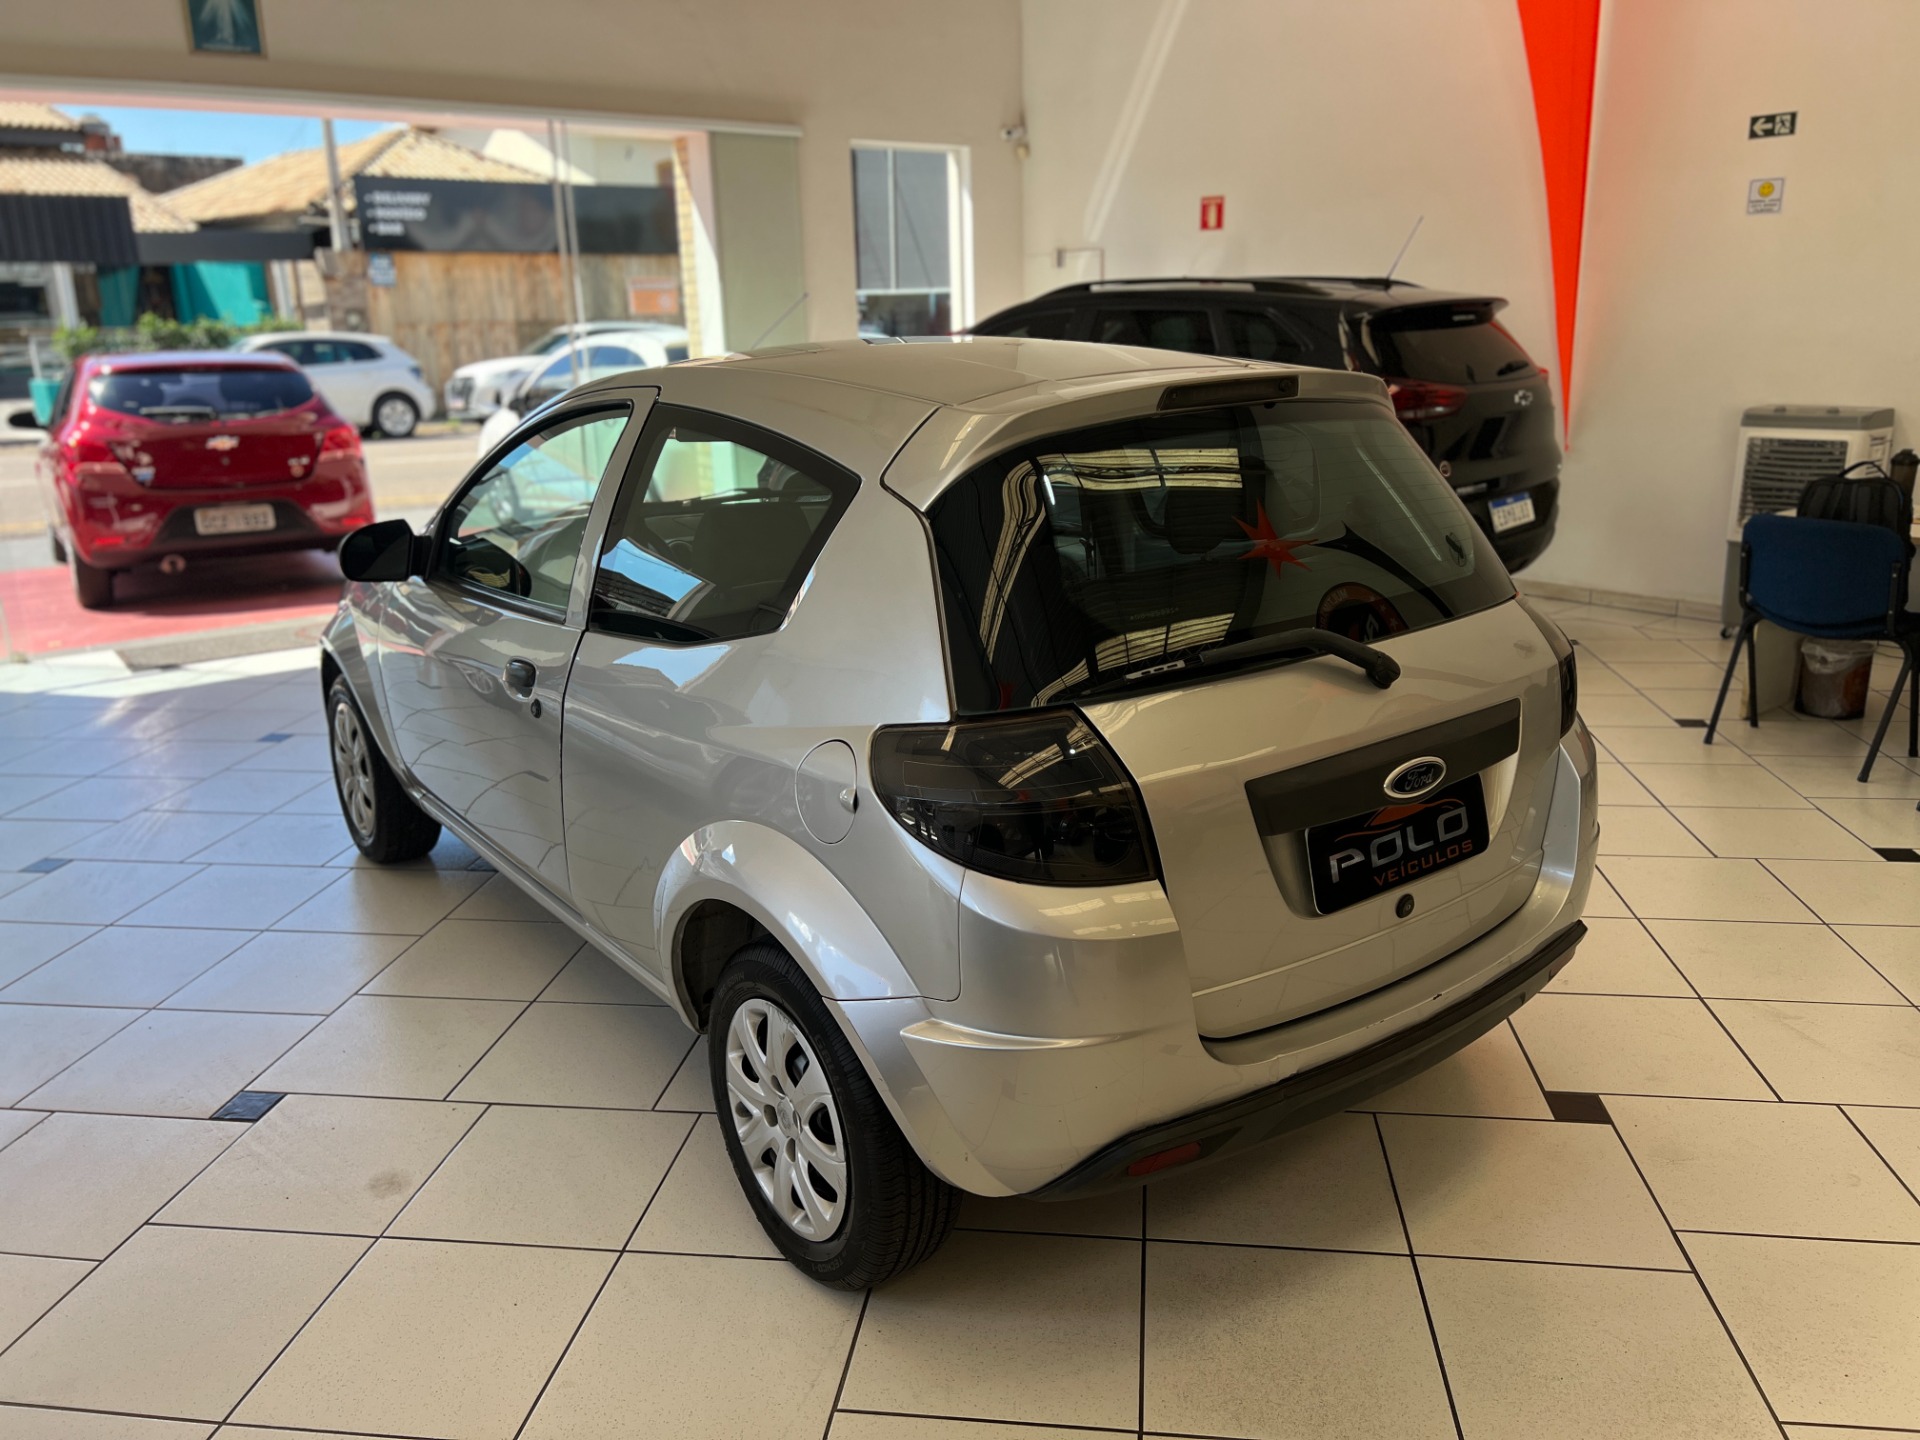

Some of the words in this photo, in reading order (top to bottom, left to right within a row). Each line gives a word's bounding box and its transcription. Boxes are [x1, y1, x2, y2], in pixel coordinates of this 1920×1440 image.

[1404, 766, 1434, 791] Ford
[1329, 805, 1469, 884] POLO
[1373, 839, 1473, 886] VEÍCULOS
